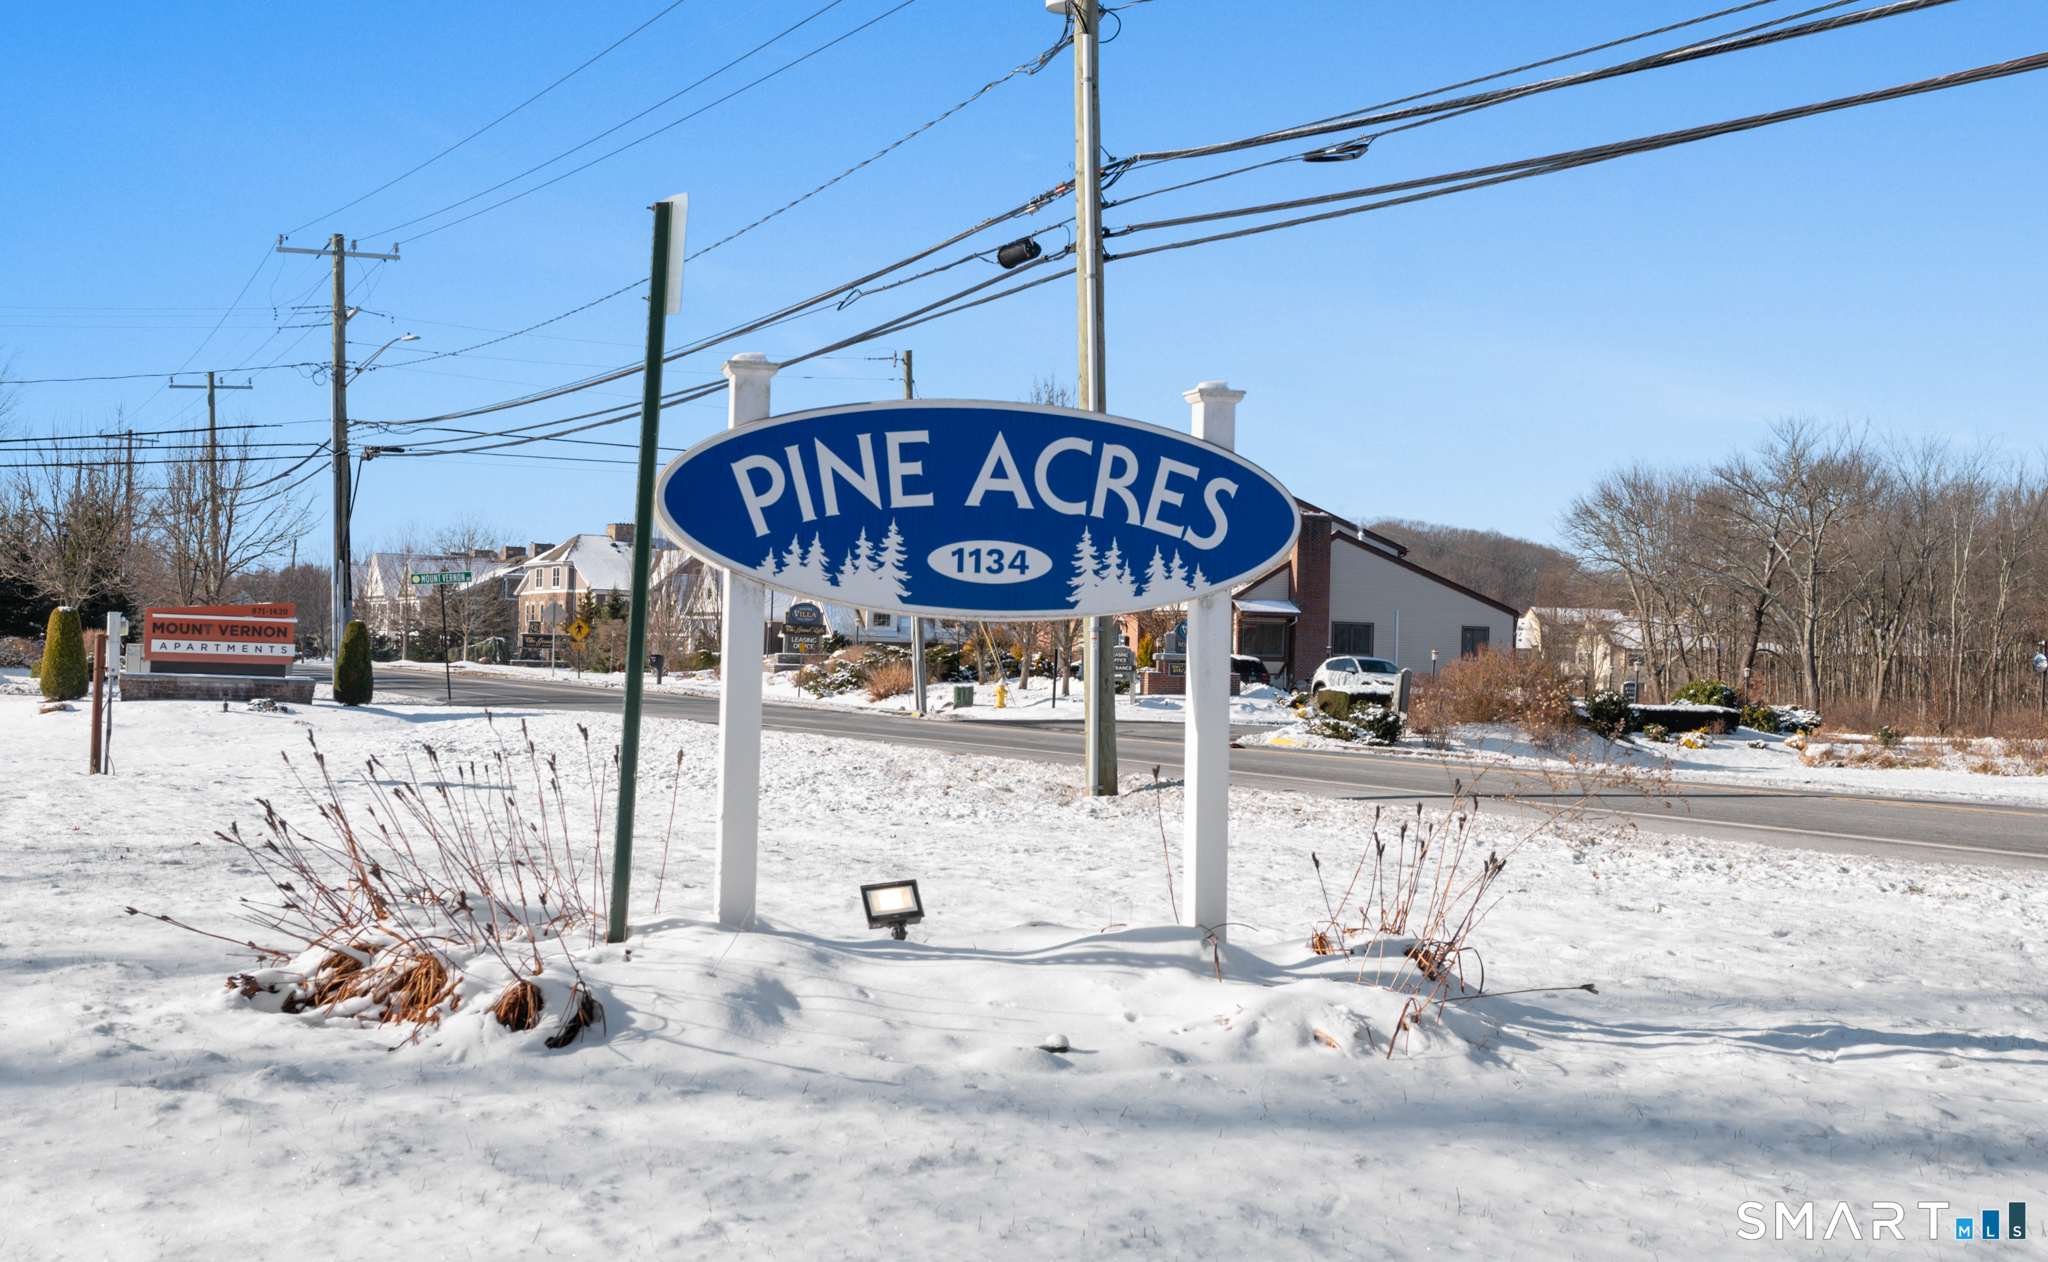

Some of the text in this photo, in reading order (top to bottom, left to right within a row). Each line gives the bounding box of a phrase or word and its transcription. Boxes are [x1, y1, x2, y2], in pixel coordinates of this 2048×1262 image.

[731, 430, 1239, 550] PINE ACRES
[951, 547, 1029, 575] 1134
[421, 574, 440, 584] MOUNT
[442, 573, 466, 583] VERNON
[251, 607, 289, 615] 871-1620
[152, 622, 287, 638] MOUNT VERNON
[160, 642, 287, 653] APARTMENTS
